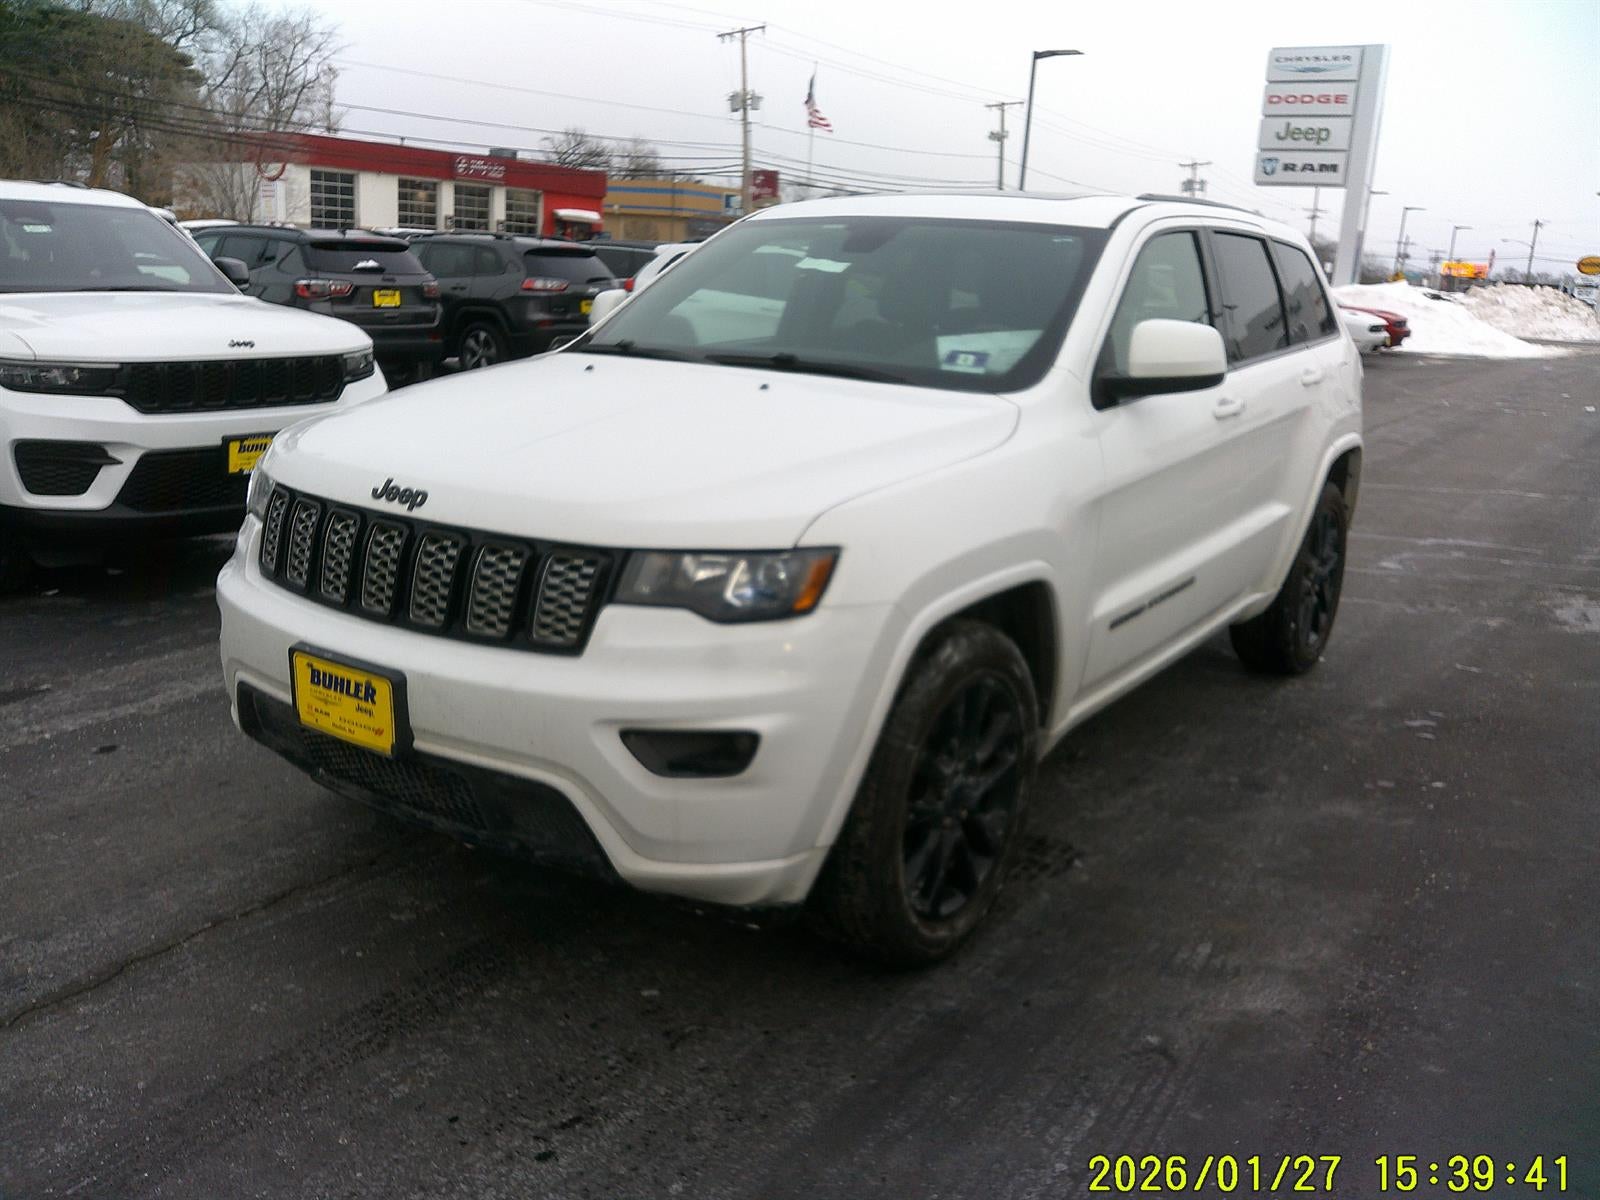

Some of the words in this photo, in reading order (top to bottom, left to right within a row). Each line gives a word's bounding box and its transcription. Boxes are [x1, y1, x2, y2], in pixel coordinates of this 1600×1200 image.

[1275, 54, 1352, 63] CHRYSLER
[1267, 94, 1349, 105] DODGE
[1276, 121, 1331, 144] Jeep
[1282, 162, 1339, 174] RAM
[371, 477, 428, 512] Jeep
[310, 668, 377, 705] BUHLER
